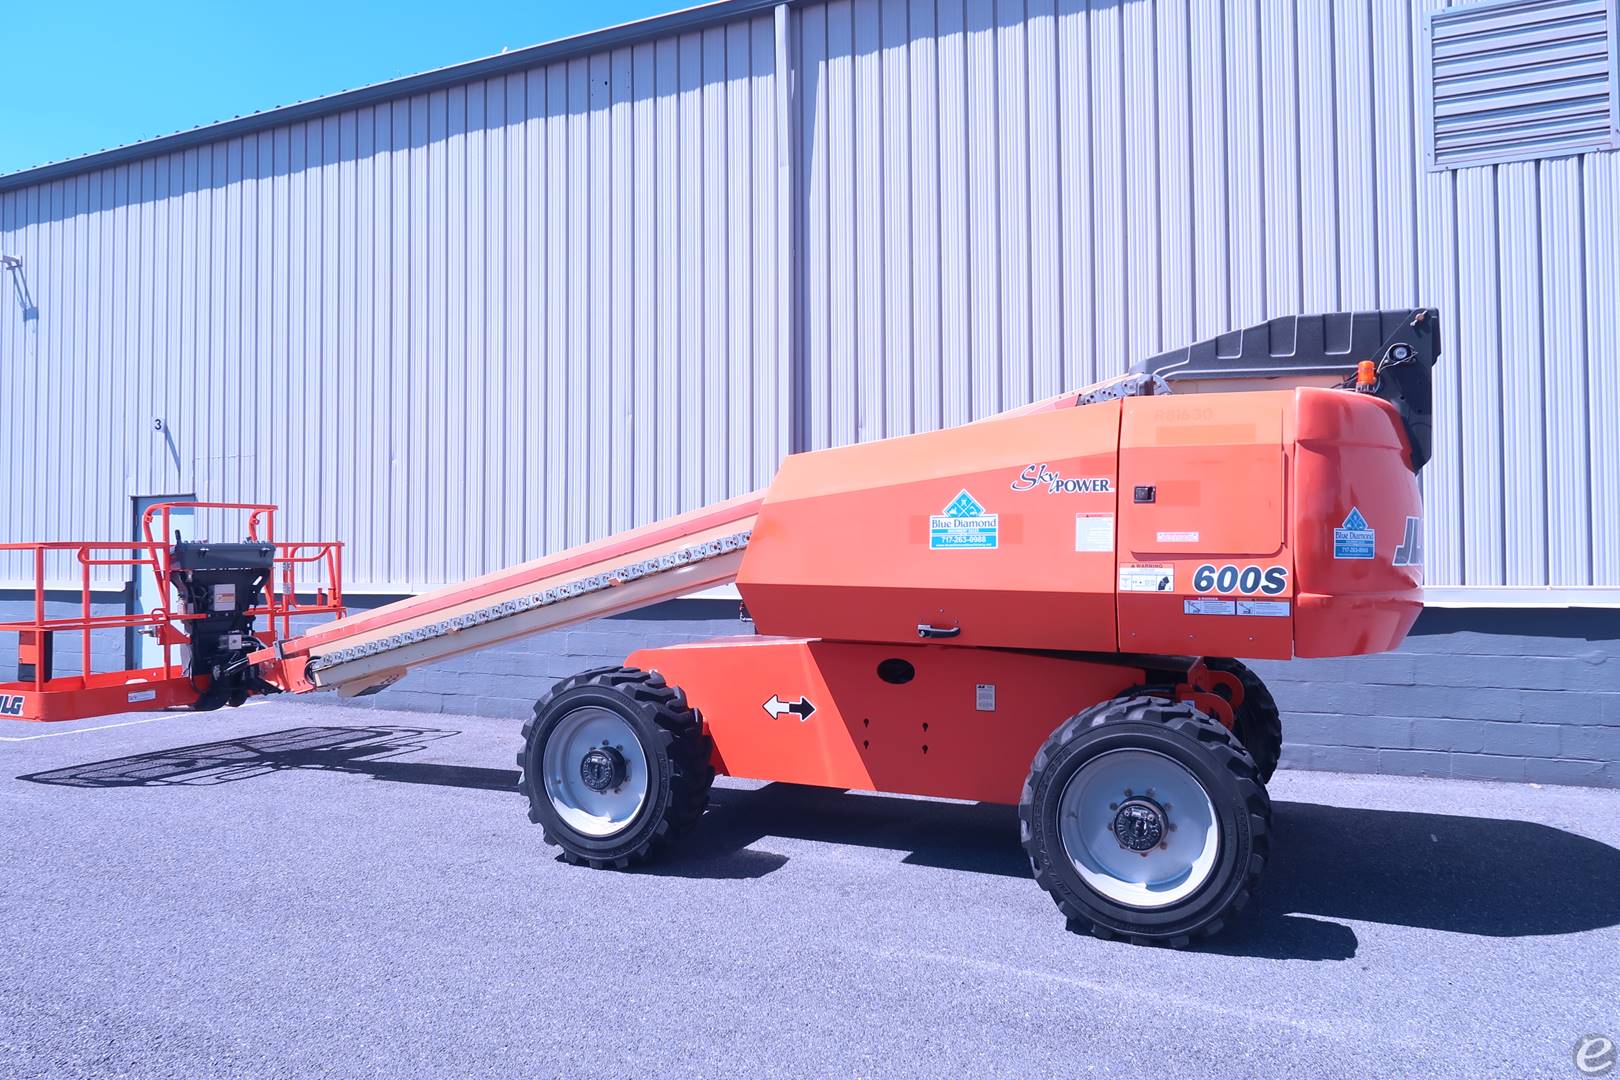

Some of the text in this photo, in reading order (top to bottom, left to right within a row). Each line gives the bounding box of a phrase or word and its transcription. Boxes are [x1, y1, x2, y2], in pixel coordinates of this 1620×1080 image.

[154, 418, 162, 431] 3
[1011, 464, 1110, 493] Sky POWER
[932, 519, 996, 528] Blue Diamond
[1194, 565, 1288, 595] 600S
